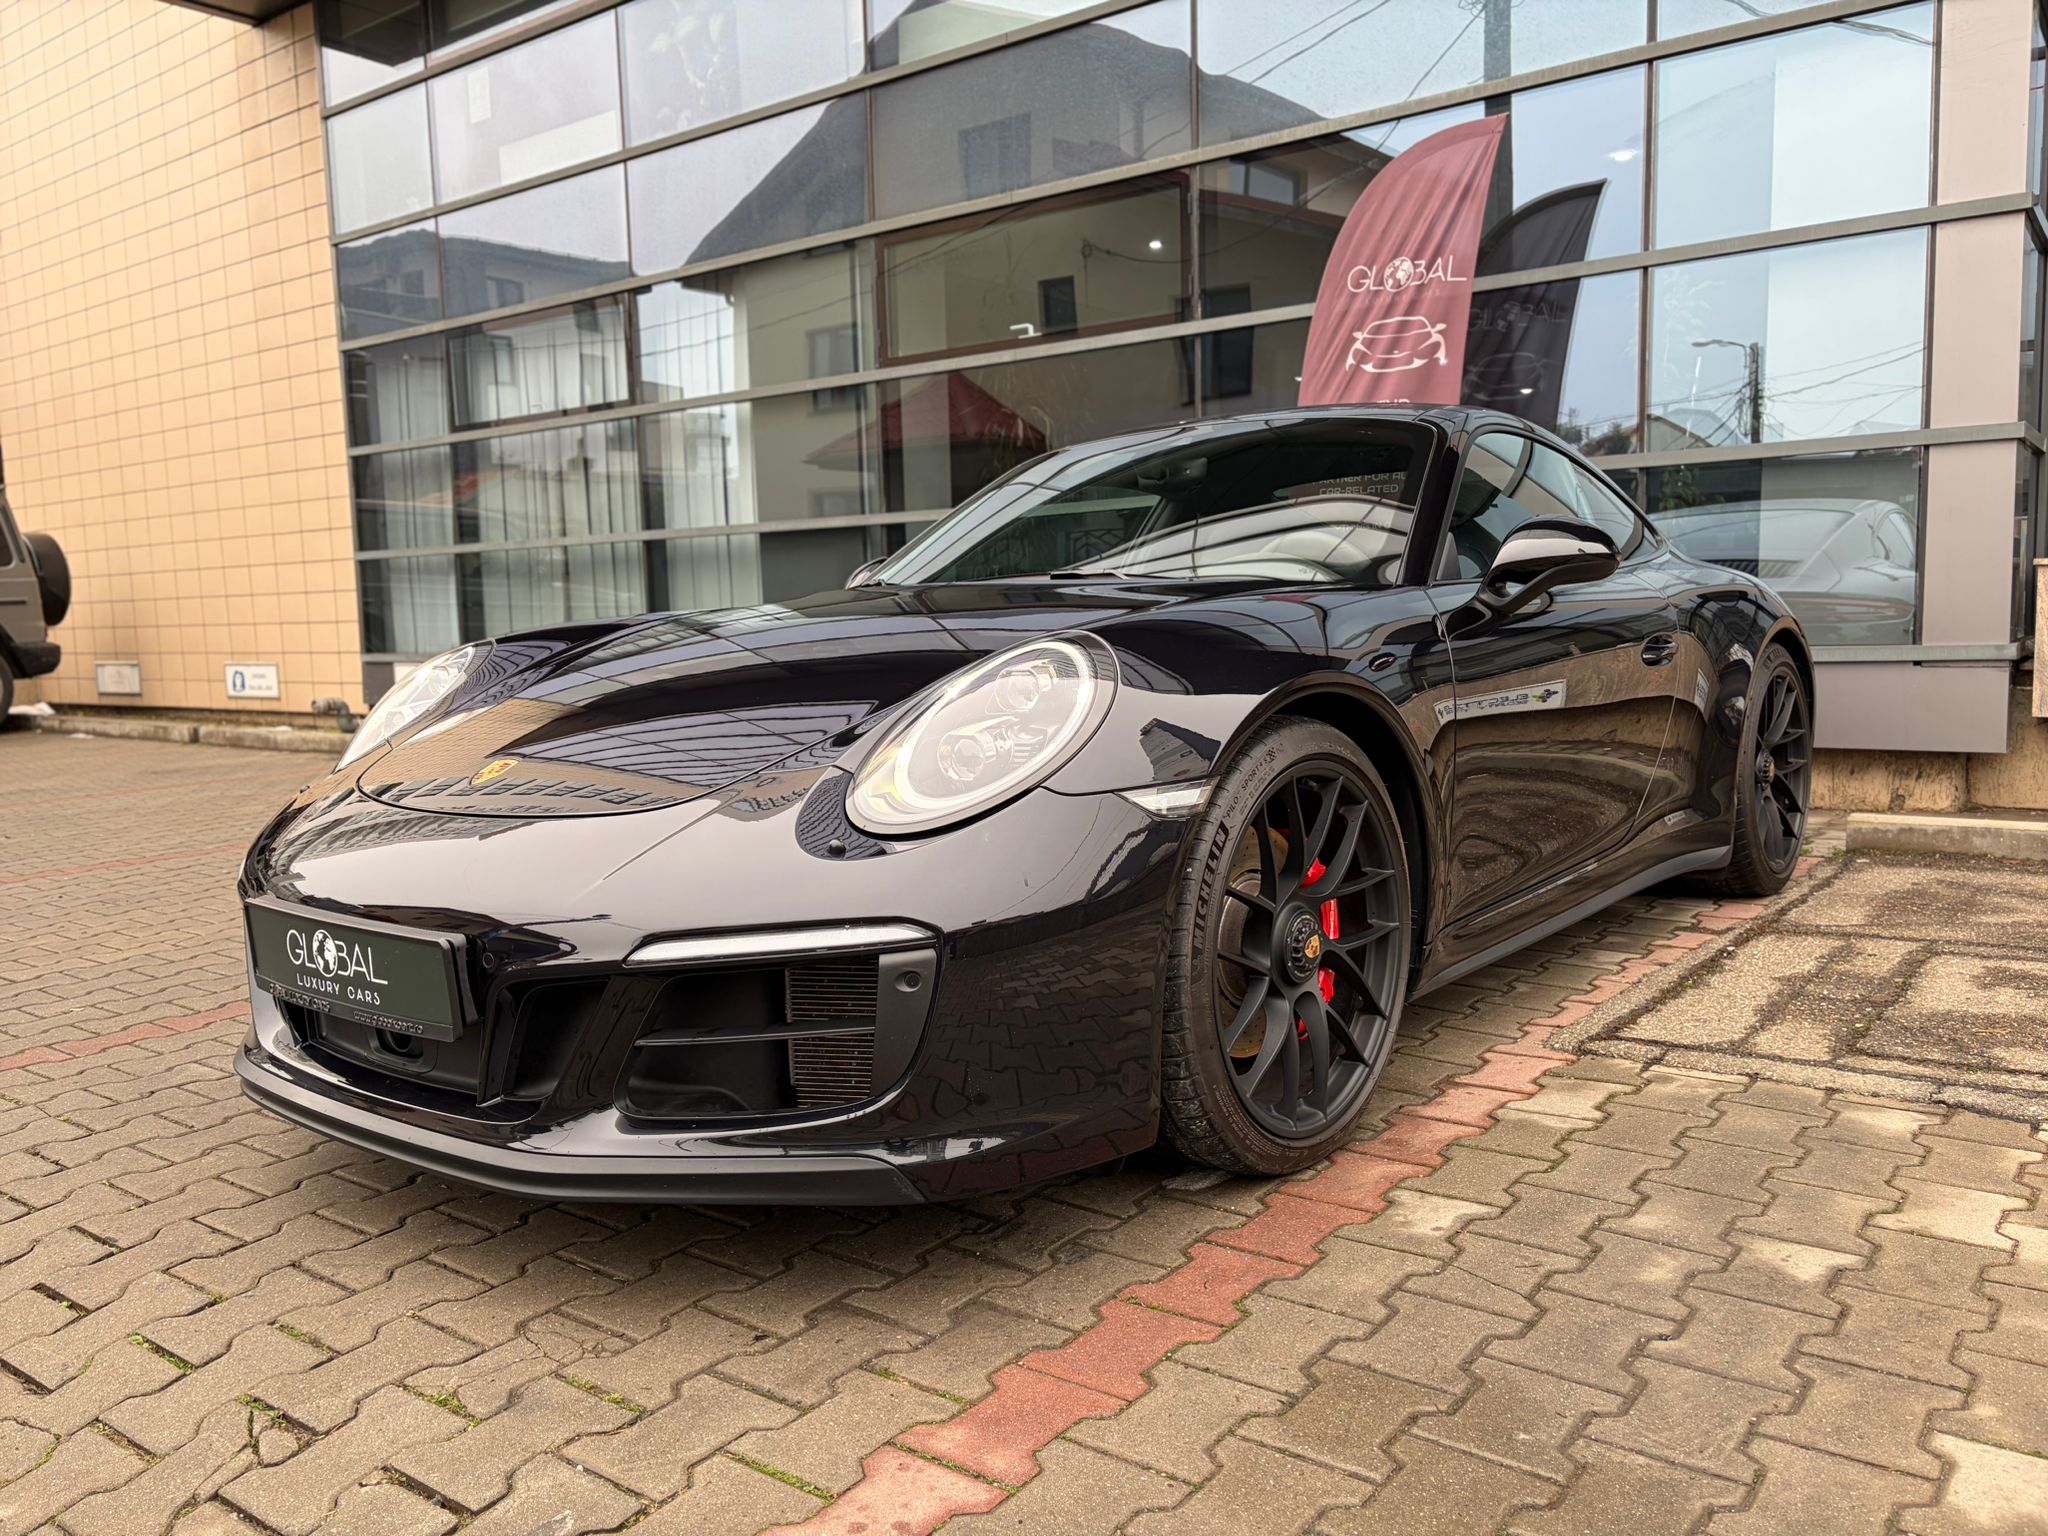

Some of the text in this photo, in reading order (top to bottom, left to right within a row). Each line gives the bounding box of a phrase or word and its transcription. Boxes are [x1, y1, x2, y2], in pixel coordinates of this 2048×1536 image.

[1347, 255, 1468, 293] GLOBAL
[1364, 473, 1389, 481] FOR
[1241, 765, 1261, 792] SPORT
[1192, 828, 1229, 951] MICHELIN
[286, 929, 388, 985] GLOBAL
[296, 973, 381, 1006] LUXURY CARS
